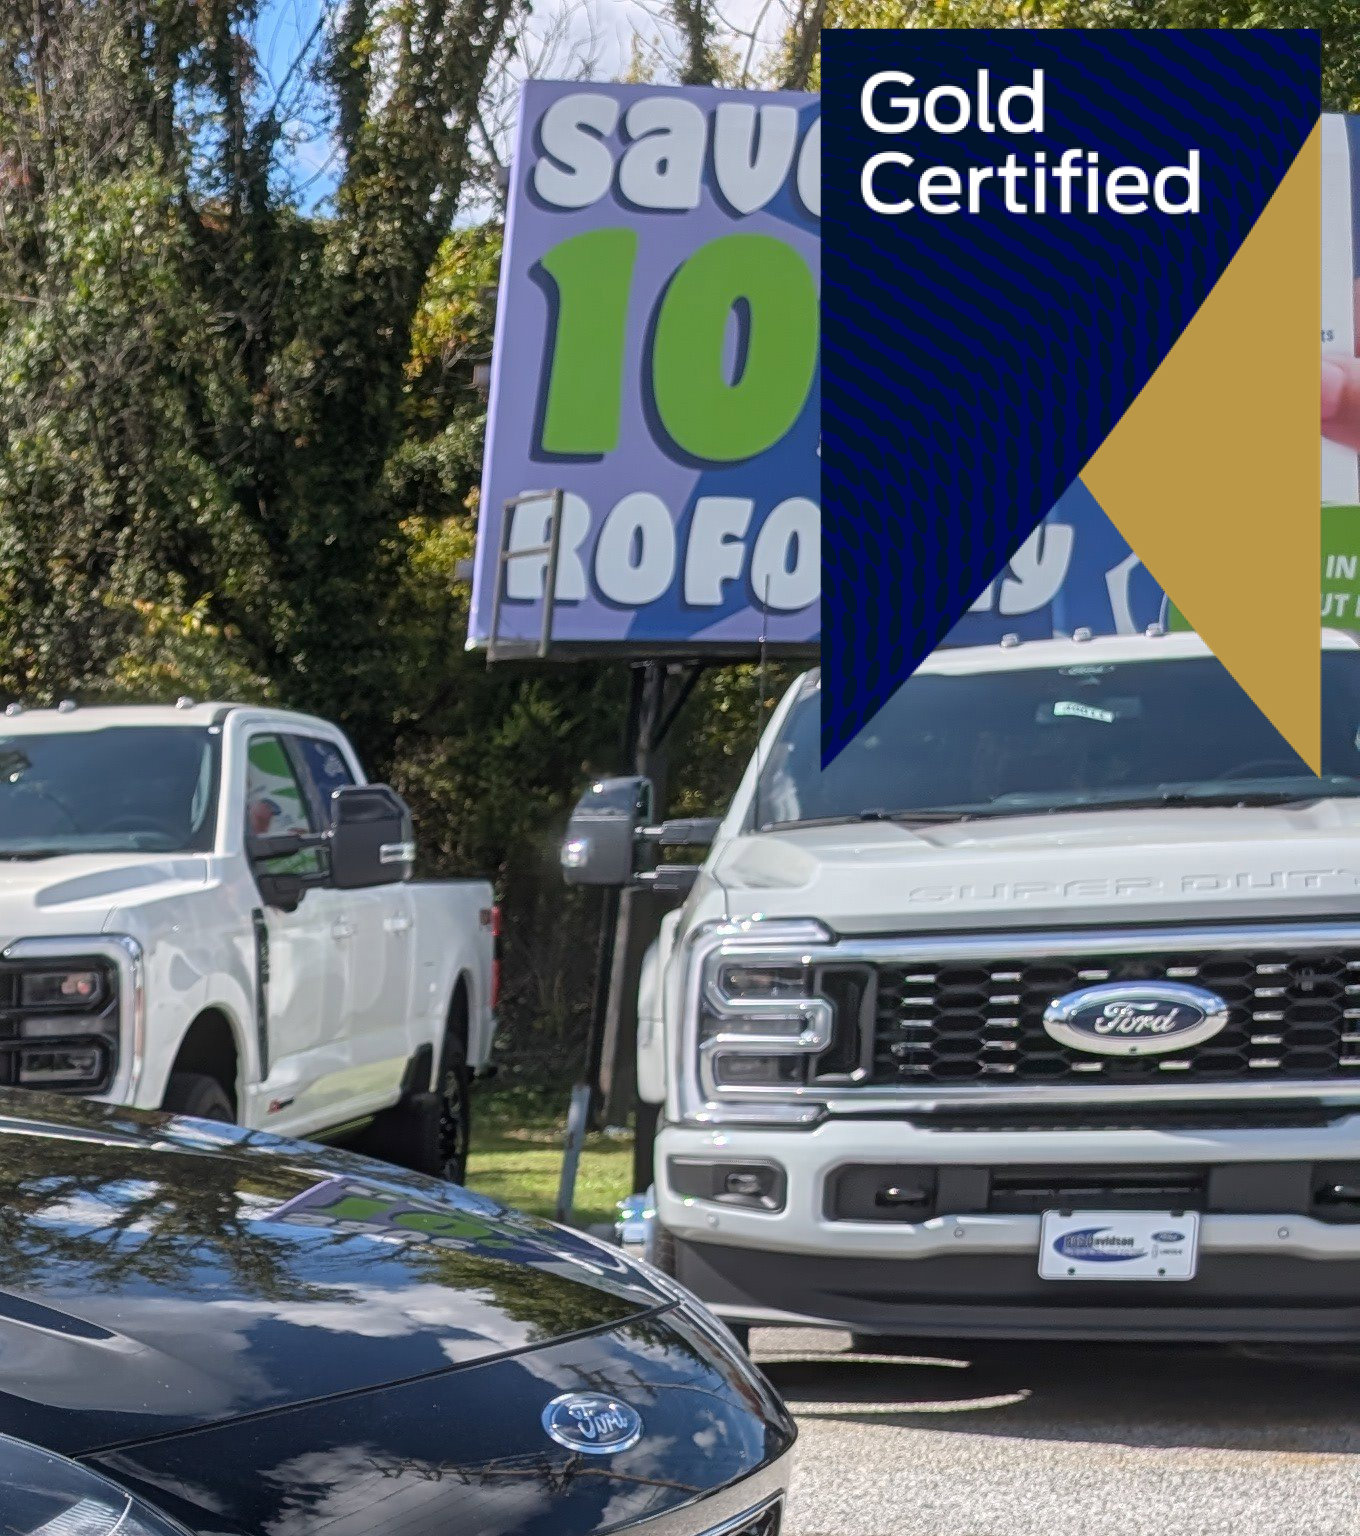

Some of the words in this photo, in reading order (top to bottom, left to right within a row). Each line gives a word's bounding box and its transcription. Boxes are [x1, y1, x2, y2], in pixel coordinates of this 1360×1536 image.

[907, 876, 1164, 904] SUPER
[1094, 1001, 1180, 1034] Ford
[567, 1399, 628, 1439] Ford
